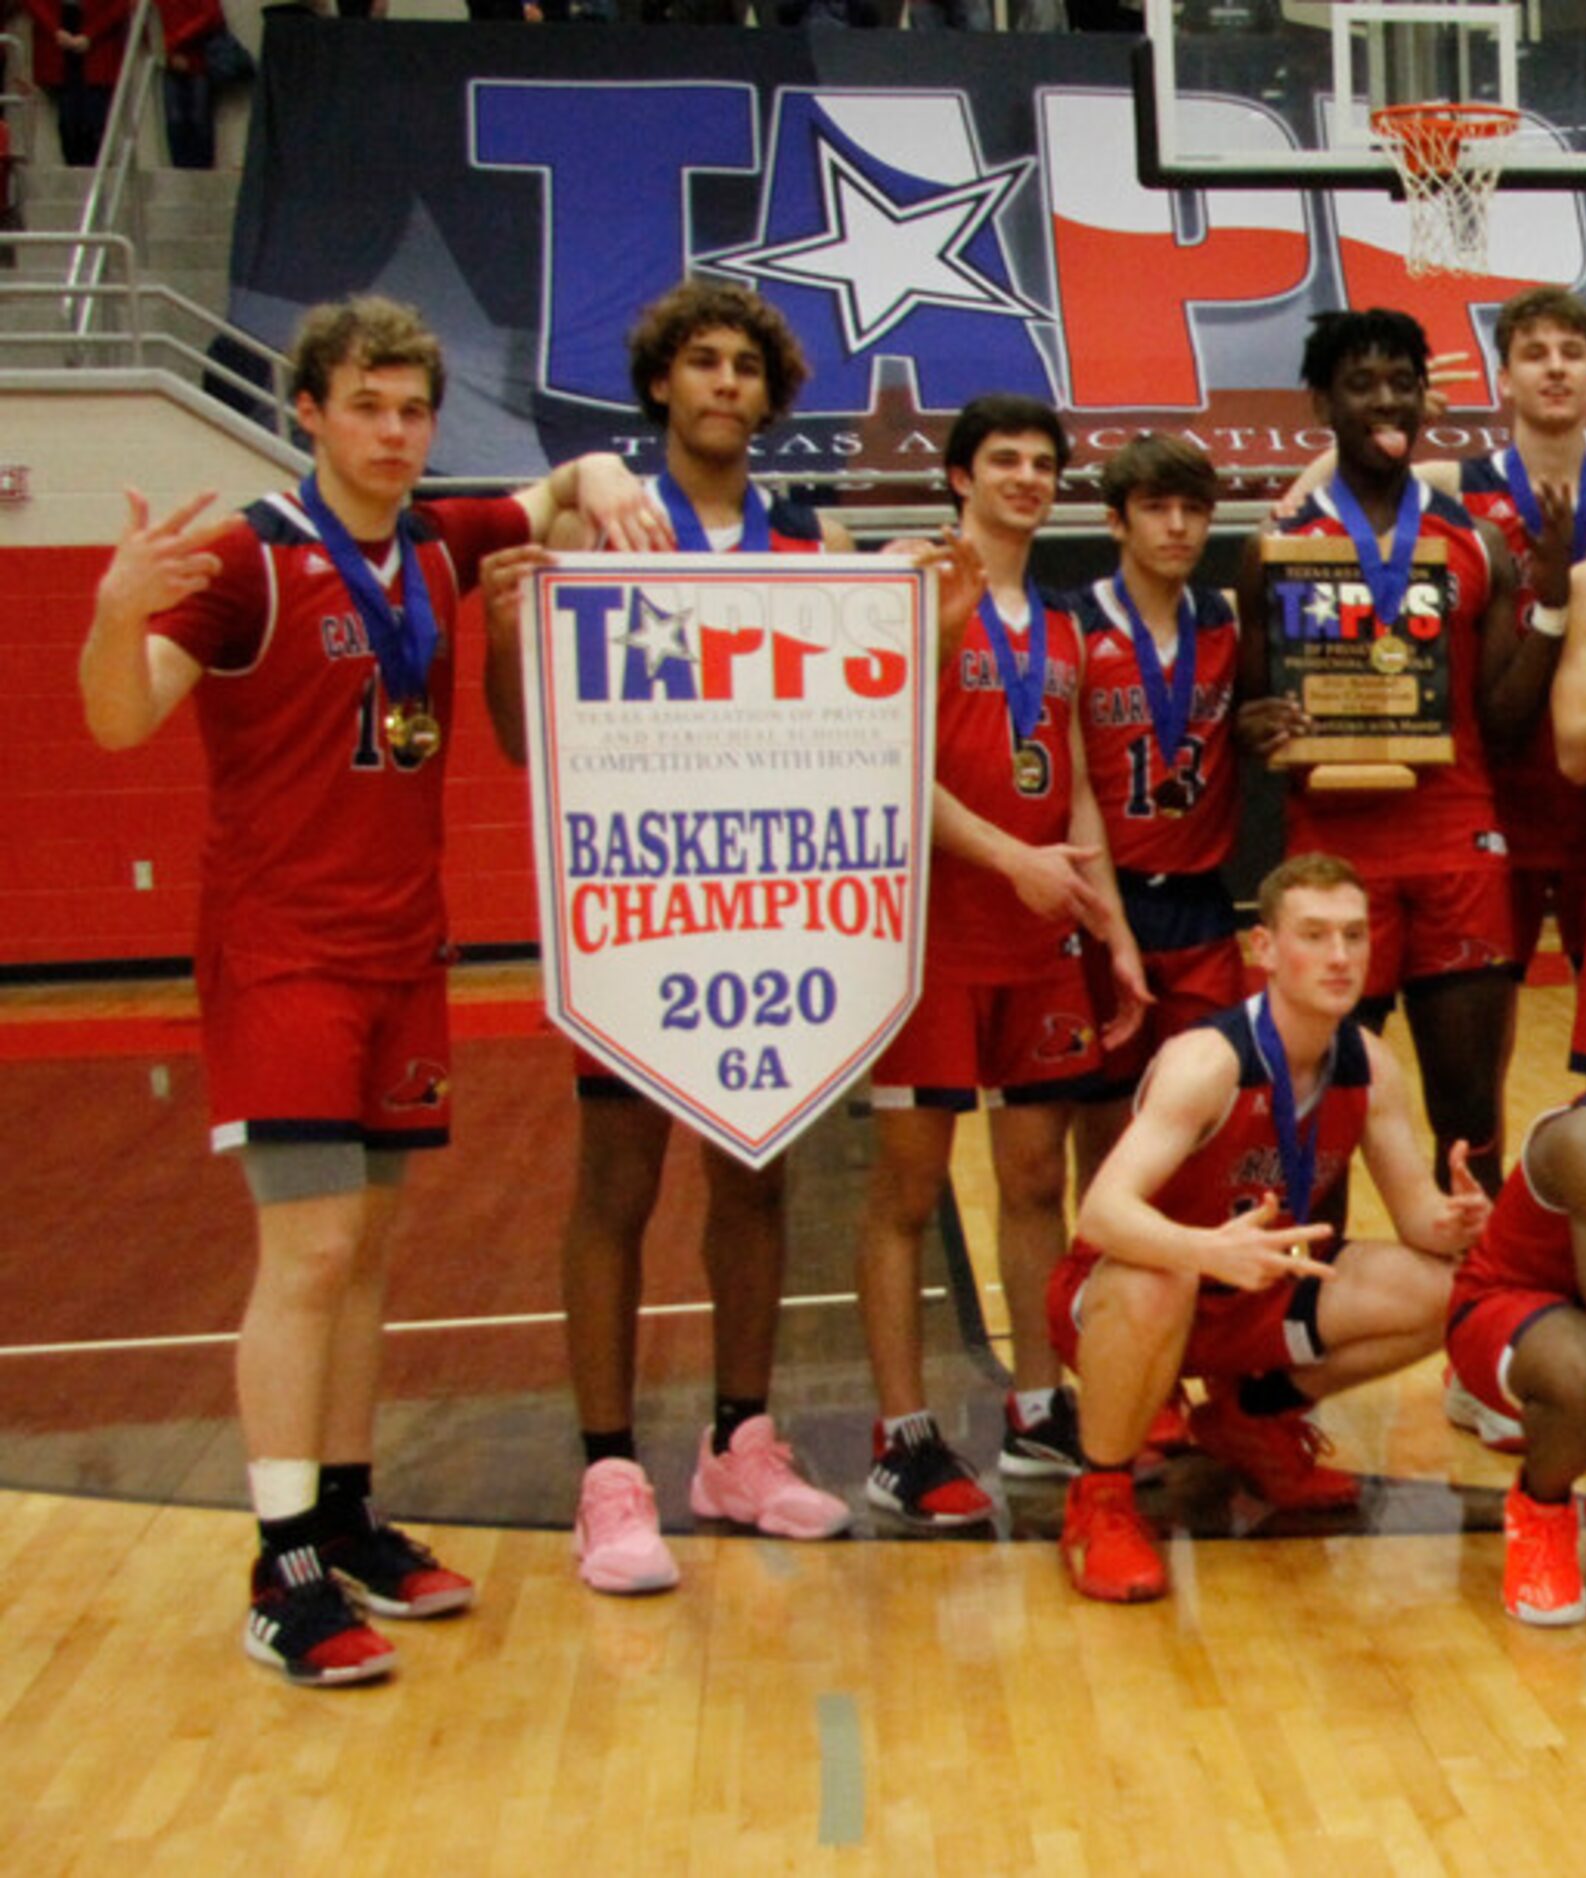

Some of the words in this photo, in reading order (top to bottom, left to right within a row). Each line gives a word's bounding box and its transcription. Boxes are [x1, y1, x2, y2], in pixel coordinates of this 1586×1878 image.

[555, 585, 909, 702] TAPPS
[569, 750, 741, 774] COMPETITION
[745, 749, 815, 771] WITH
[815, 747, 901, 769] HONOR
[565, 805, 908, 879] BASKETBALL
[570, 874, 907, 955] CHAMPION
[658, 967, 838, 1031] 2020
[717, 1045, 791, 1092] 6A
